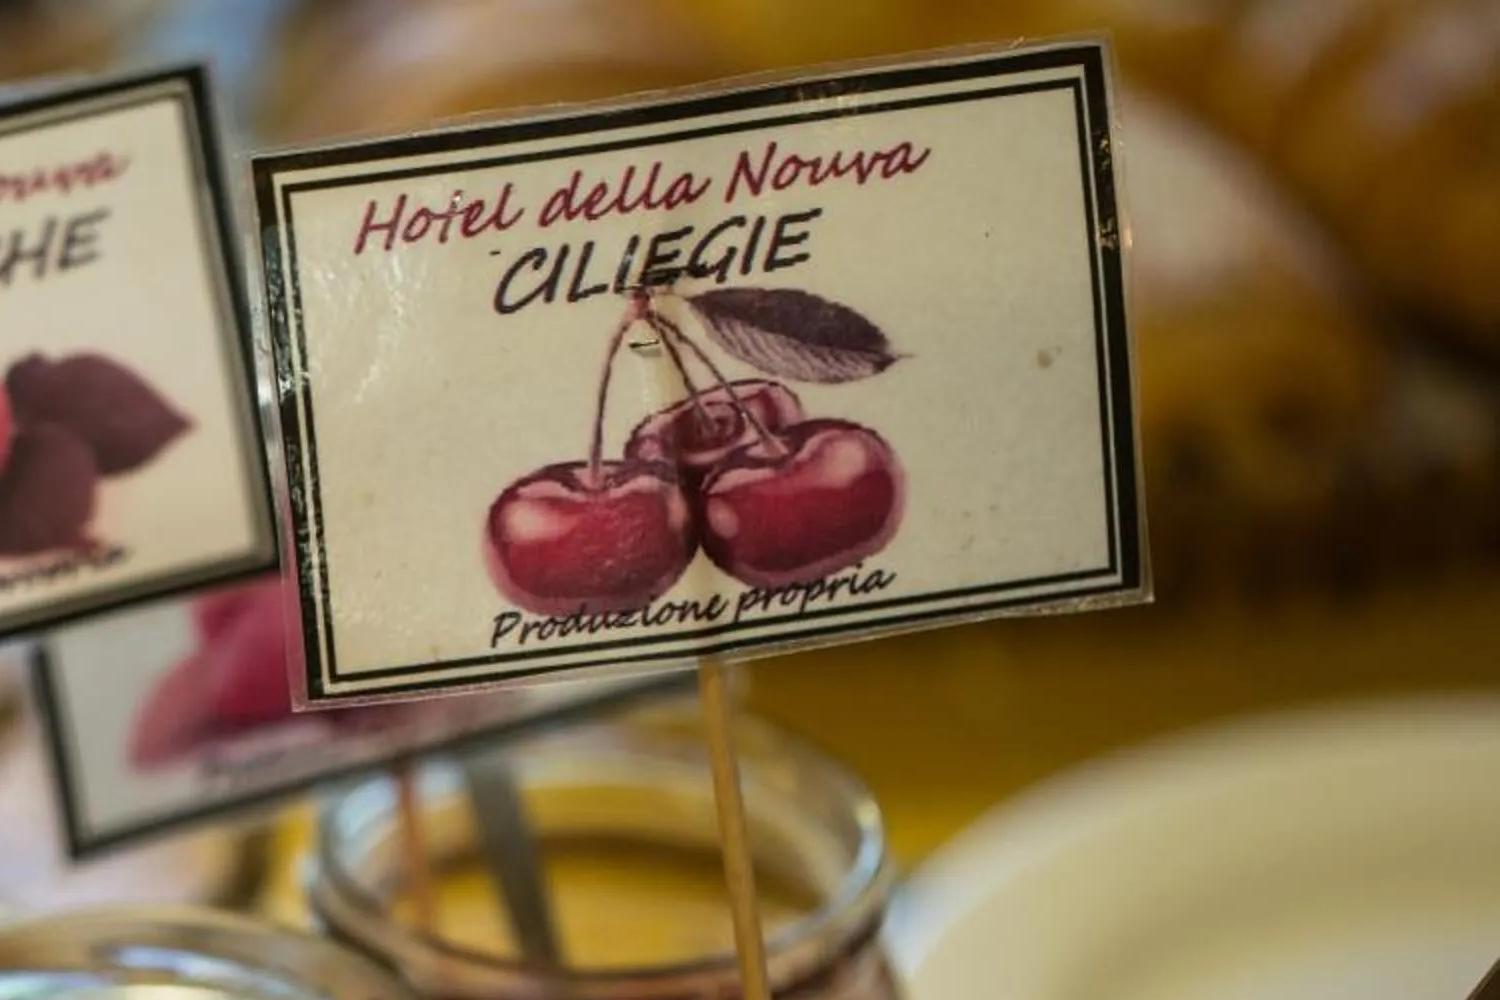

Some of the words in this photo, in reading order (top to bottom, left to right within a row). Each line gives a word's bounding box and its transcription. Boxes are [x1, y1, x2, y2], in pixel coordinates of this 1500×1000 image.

[353, 182, 524, 255] Hotel
[537, 160, 713, 228] della
[726, 138, 931, 199] Nouva
[492, 207, 824, 315] CILIEGIE
[490, 592, 731, 648] Produzione
[734, 560, 897, 624] propria
